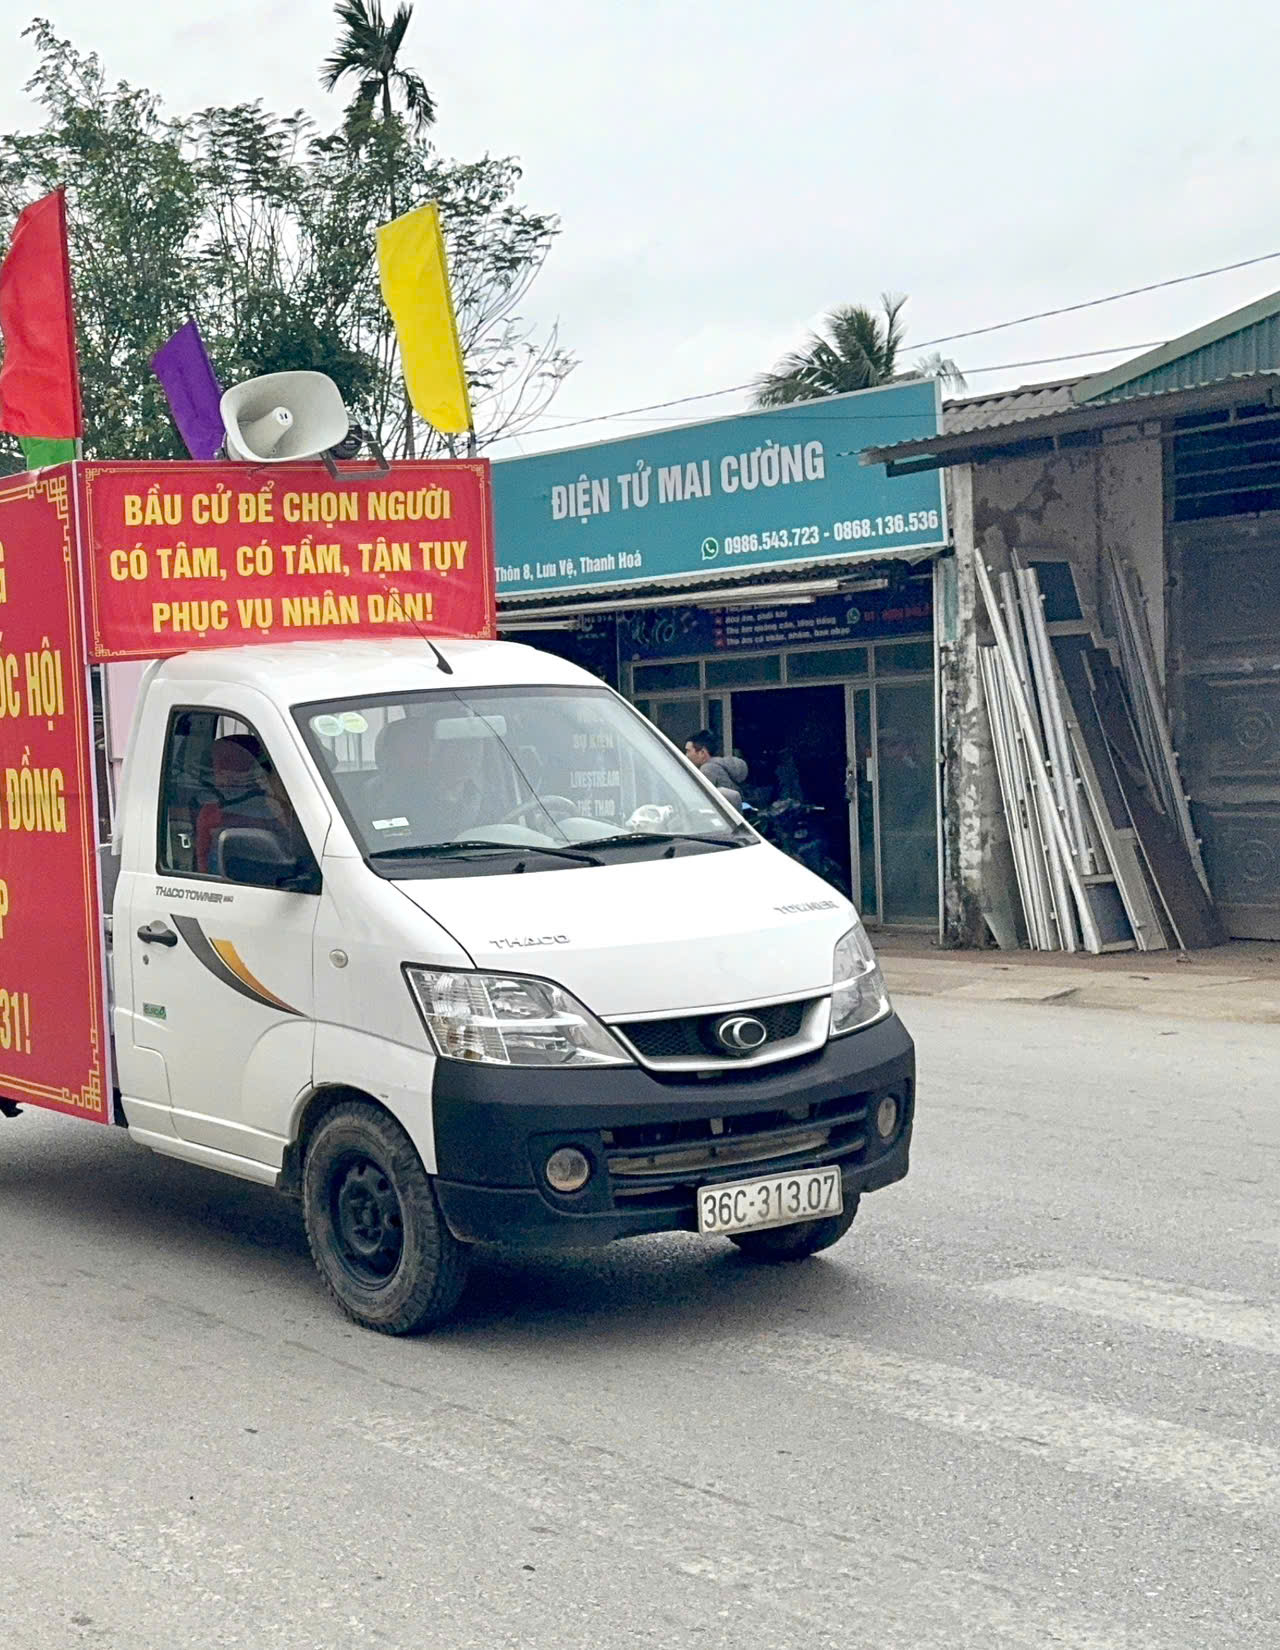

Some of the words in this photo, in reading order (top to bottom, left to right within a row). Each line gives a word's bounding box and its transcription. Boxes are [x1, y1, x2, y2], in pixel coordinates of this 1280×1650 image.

[125, 484, 181, 526] BẦU
[191, 483, 233, 524] CỬ
[238, 480, 275, 522] ĐỂ
[283, 491, 358, 528] CHỌN
[368, 483, 450, 520] NGƯỜI
[551, 474, 610, 524] ĐIỆN
[617, 459, 651, 510] TỬ
[658, 459, 711, 504] MAI
[720, 439, 825, 493] CƯỜNG
[724, 526, 819, 555] 0986.543.723
[834, 510, 938, 540] 0868.136.536
[109, 542, 148, 580] CÓ
[157, 541, 227, 581] TÂM,
[236, 539, 273, 577] CÓ
[281, 534, 349, 577] TẦM,
[358, 537, 413, 578] TẬN
[419, 541, 467, 576] TỤY
[495, 566, 520, 582] Thôn
[523, 564, 534, 581] 8,
[536, 562, 556, 579] Lưu
[559, 558, 577, 578] Vệ,
[580, 554, 615, 574] Thanh
[618, 550, 642, 569] Hoá
[152, 600, 228, 637] PHỤC
[237, 600, 273, 634] VỤ
[282, 590, 359, 626] NHÂN
[368, 587, 433, 623] DÂN!
[25, 637, 64, 731] HỘI
[5, 746, 67, 832] ĐỒNG
[156, 886, 184, 898] THACO
[185, 890, 223, 904] TOWNER
[489, 934, 570, 950] THACO
[703, 1175, 835, 1229] 36C-313.07
